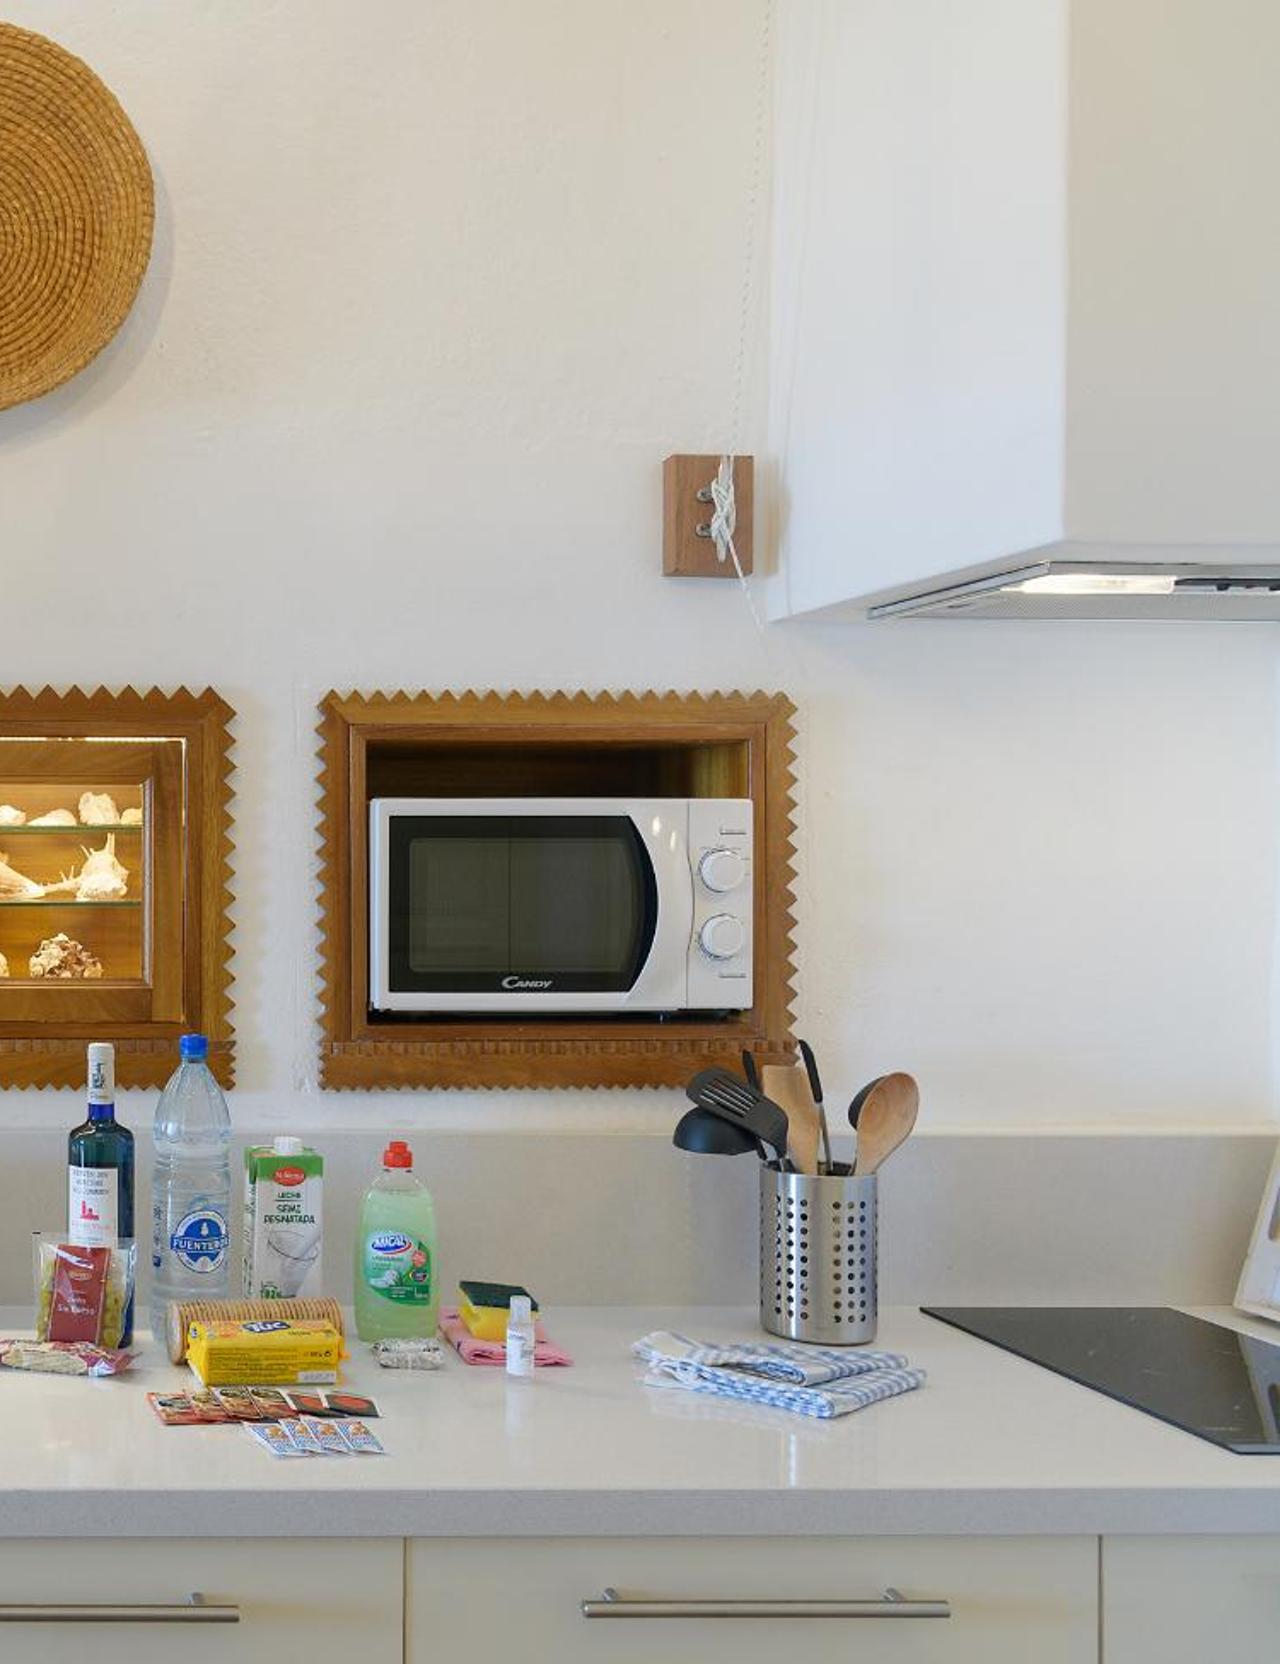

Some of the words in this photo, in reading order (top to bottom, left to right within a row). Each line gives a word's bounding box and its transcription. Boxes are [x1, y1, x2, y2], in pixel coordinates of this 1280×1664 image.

[502, 975, 553, 989] CANDY
[276, 1204, 302, 1214] SEMI
[263, 1214, 315, 1225] DESNATADA
